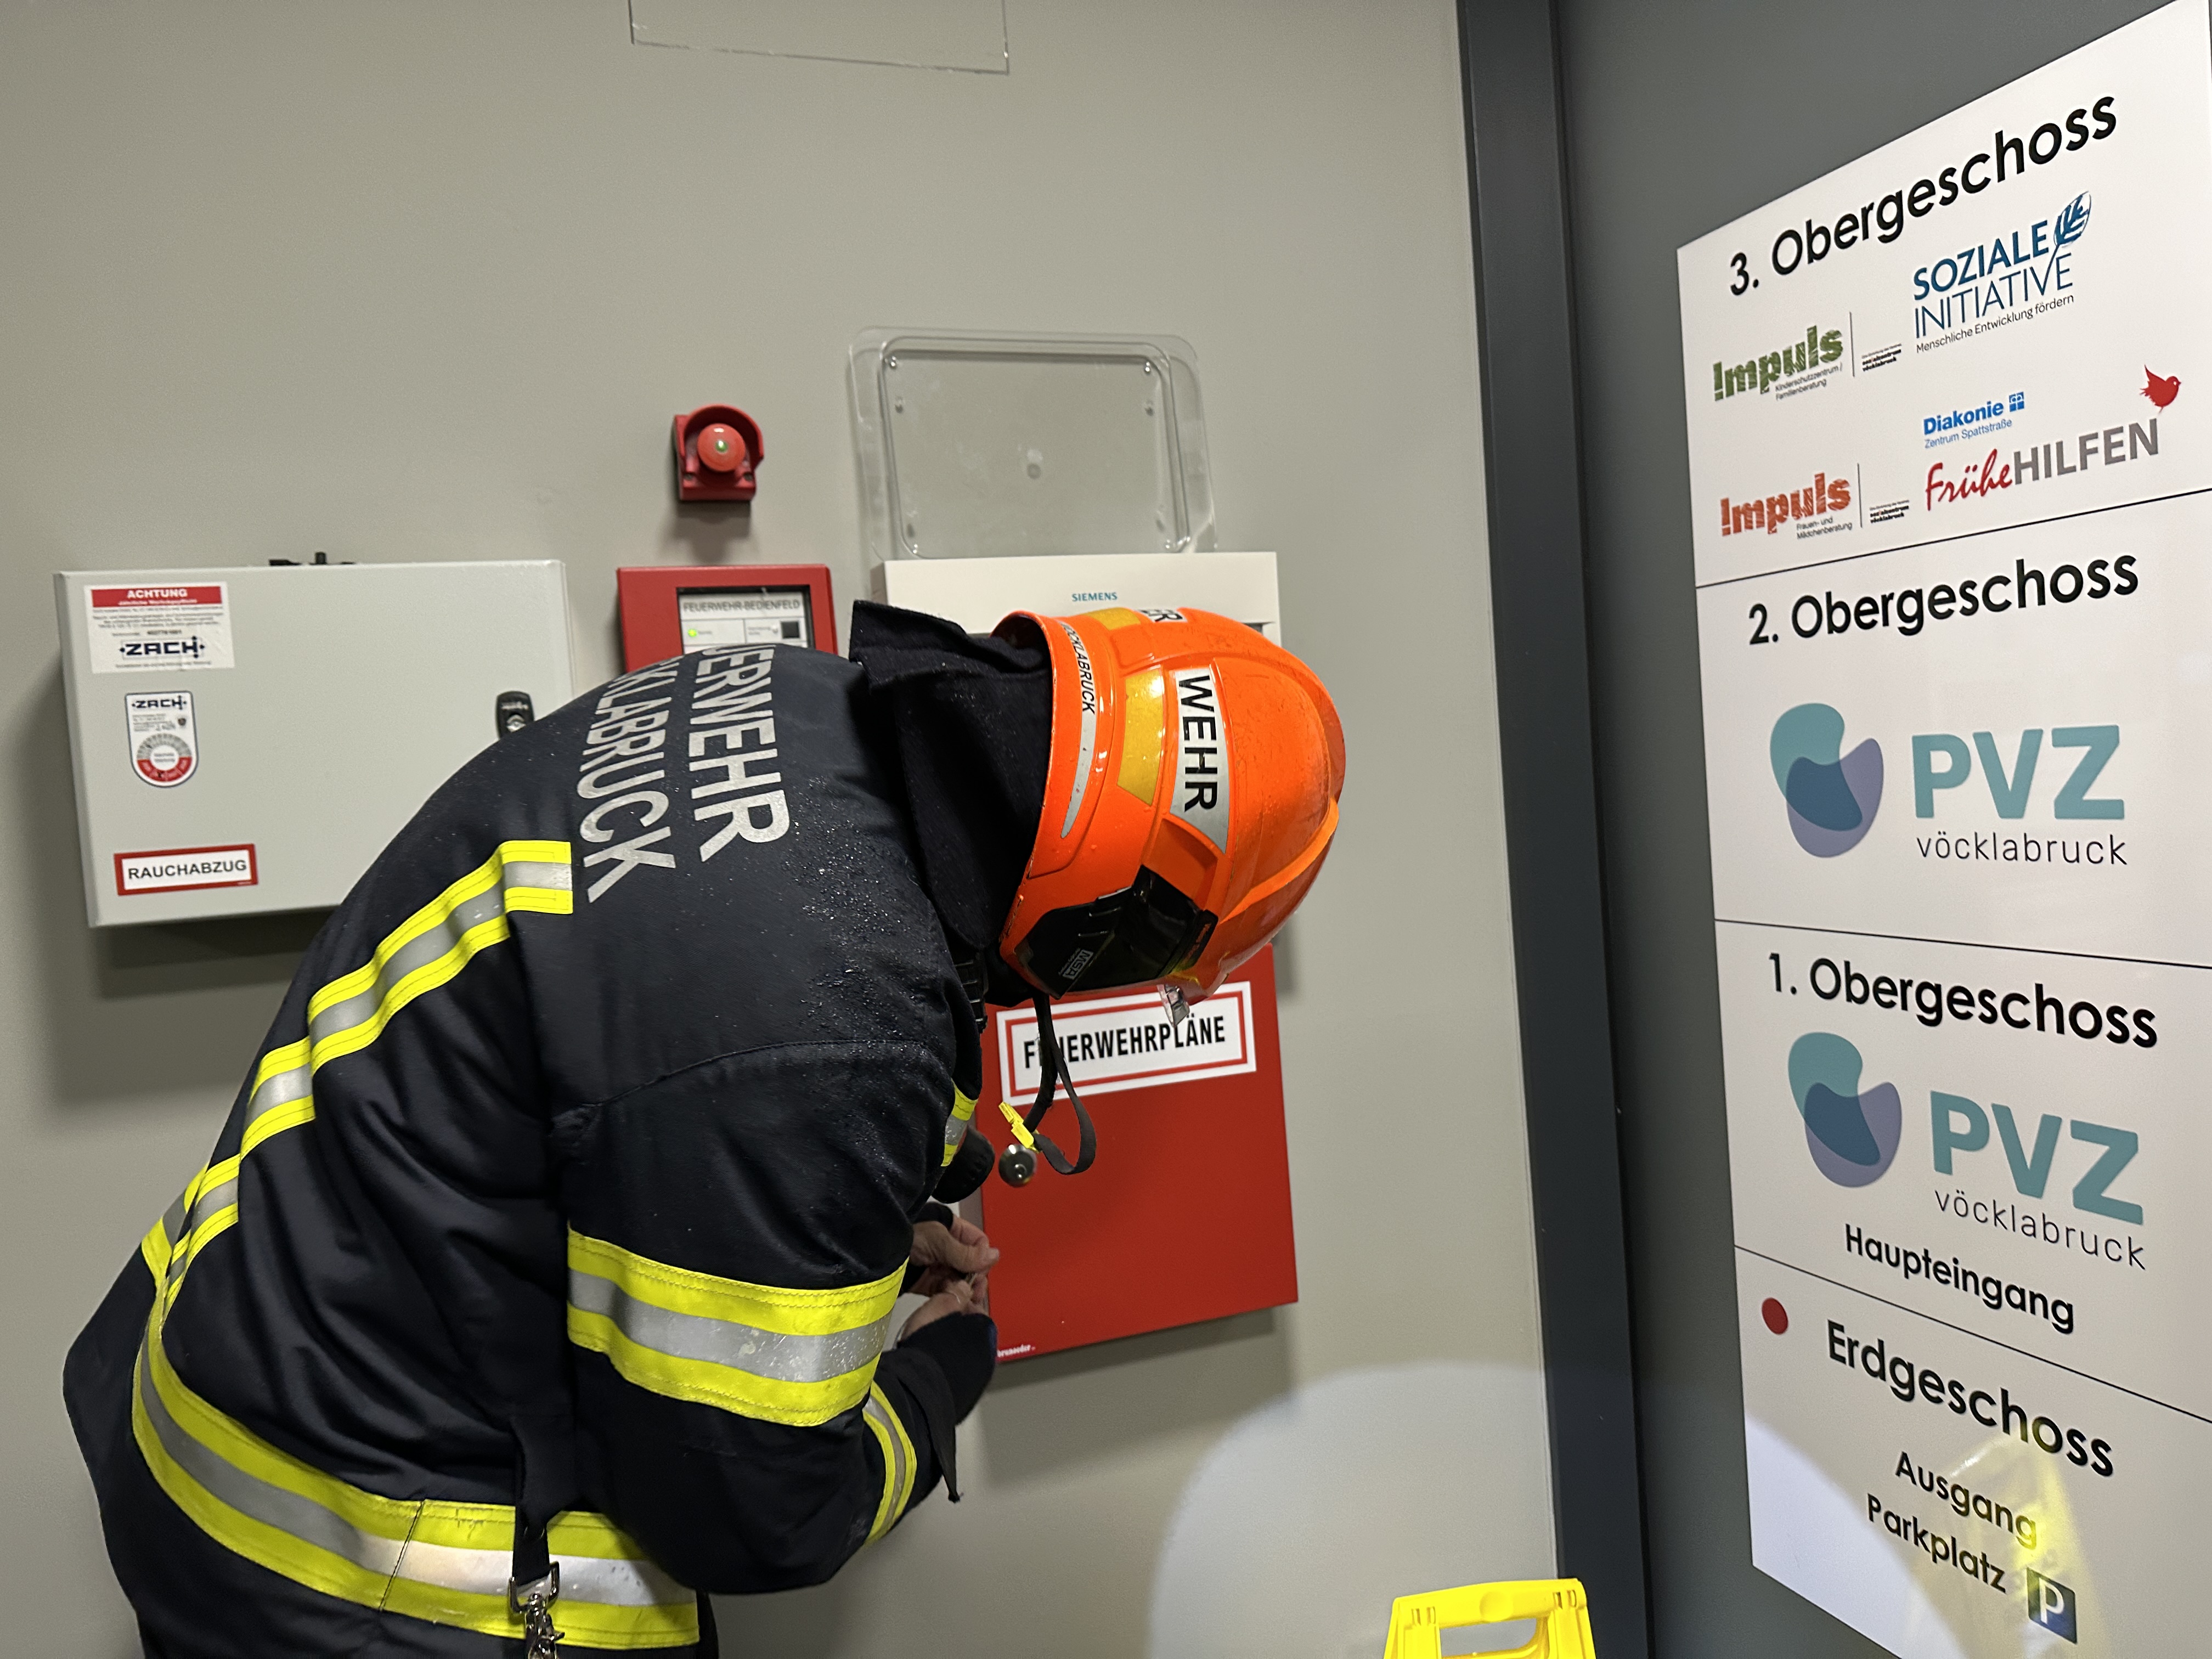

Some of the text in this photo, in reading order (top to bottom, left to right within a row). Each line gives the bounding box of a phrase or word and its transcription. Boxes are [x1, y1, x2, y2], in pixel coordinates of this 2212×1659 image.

[1730, 96, 2117, 296] 3. Obergeschoss
[1914, 219, 2049, 301] SOZIALE
[1915, 252, 2073, 338] INITIATIVE
[1916, 328, 1973, 353] Menschliche
[1975, 308, 2033, 335] Entwicklung
[2035, 295, 2074, 320] fördern
[1923, 401, 2004, 435] Diakonie
[1925, 419, 2012, 449] Zentrum Spattstraße
[127, 588, 188, 599] ACHTUNG
[1071, 592, 1118, 602] SIEMENS
[1749, 554, 2140, 645] 2. Obergeschoss
[125, 638, 199, 657] ZACH
[136, 696, 183, 709] ZACH
[1178, 675, 1218, 812] WEHR
[1911, 725, 2125, 820] PVZ
[128, 860, 247, 879] RAUCHABZUG
[1916, 831, 2128, 866] vöcklabruck
[1024, 1013, 1225, 1069] FERWEHRPLÄNE
[1768, 953, 2158, 1048] 1. Obergeschoss
[1930, 1090, 2143, 1226] PVZ
[1935, 1189, 2146, 1271] vöcklabruck
[1845, 1223, 2074, 1335] Haupteingang
[1827, 1319, 2114, 1477] Erdgeschoss
[1895, 1451, 2038, 1550] Ausgang
[1867, 1493, 2006, 1594] Parkplatz
